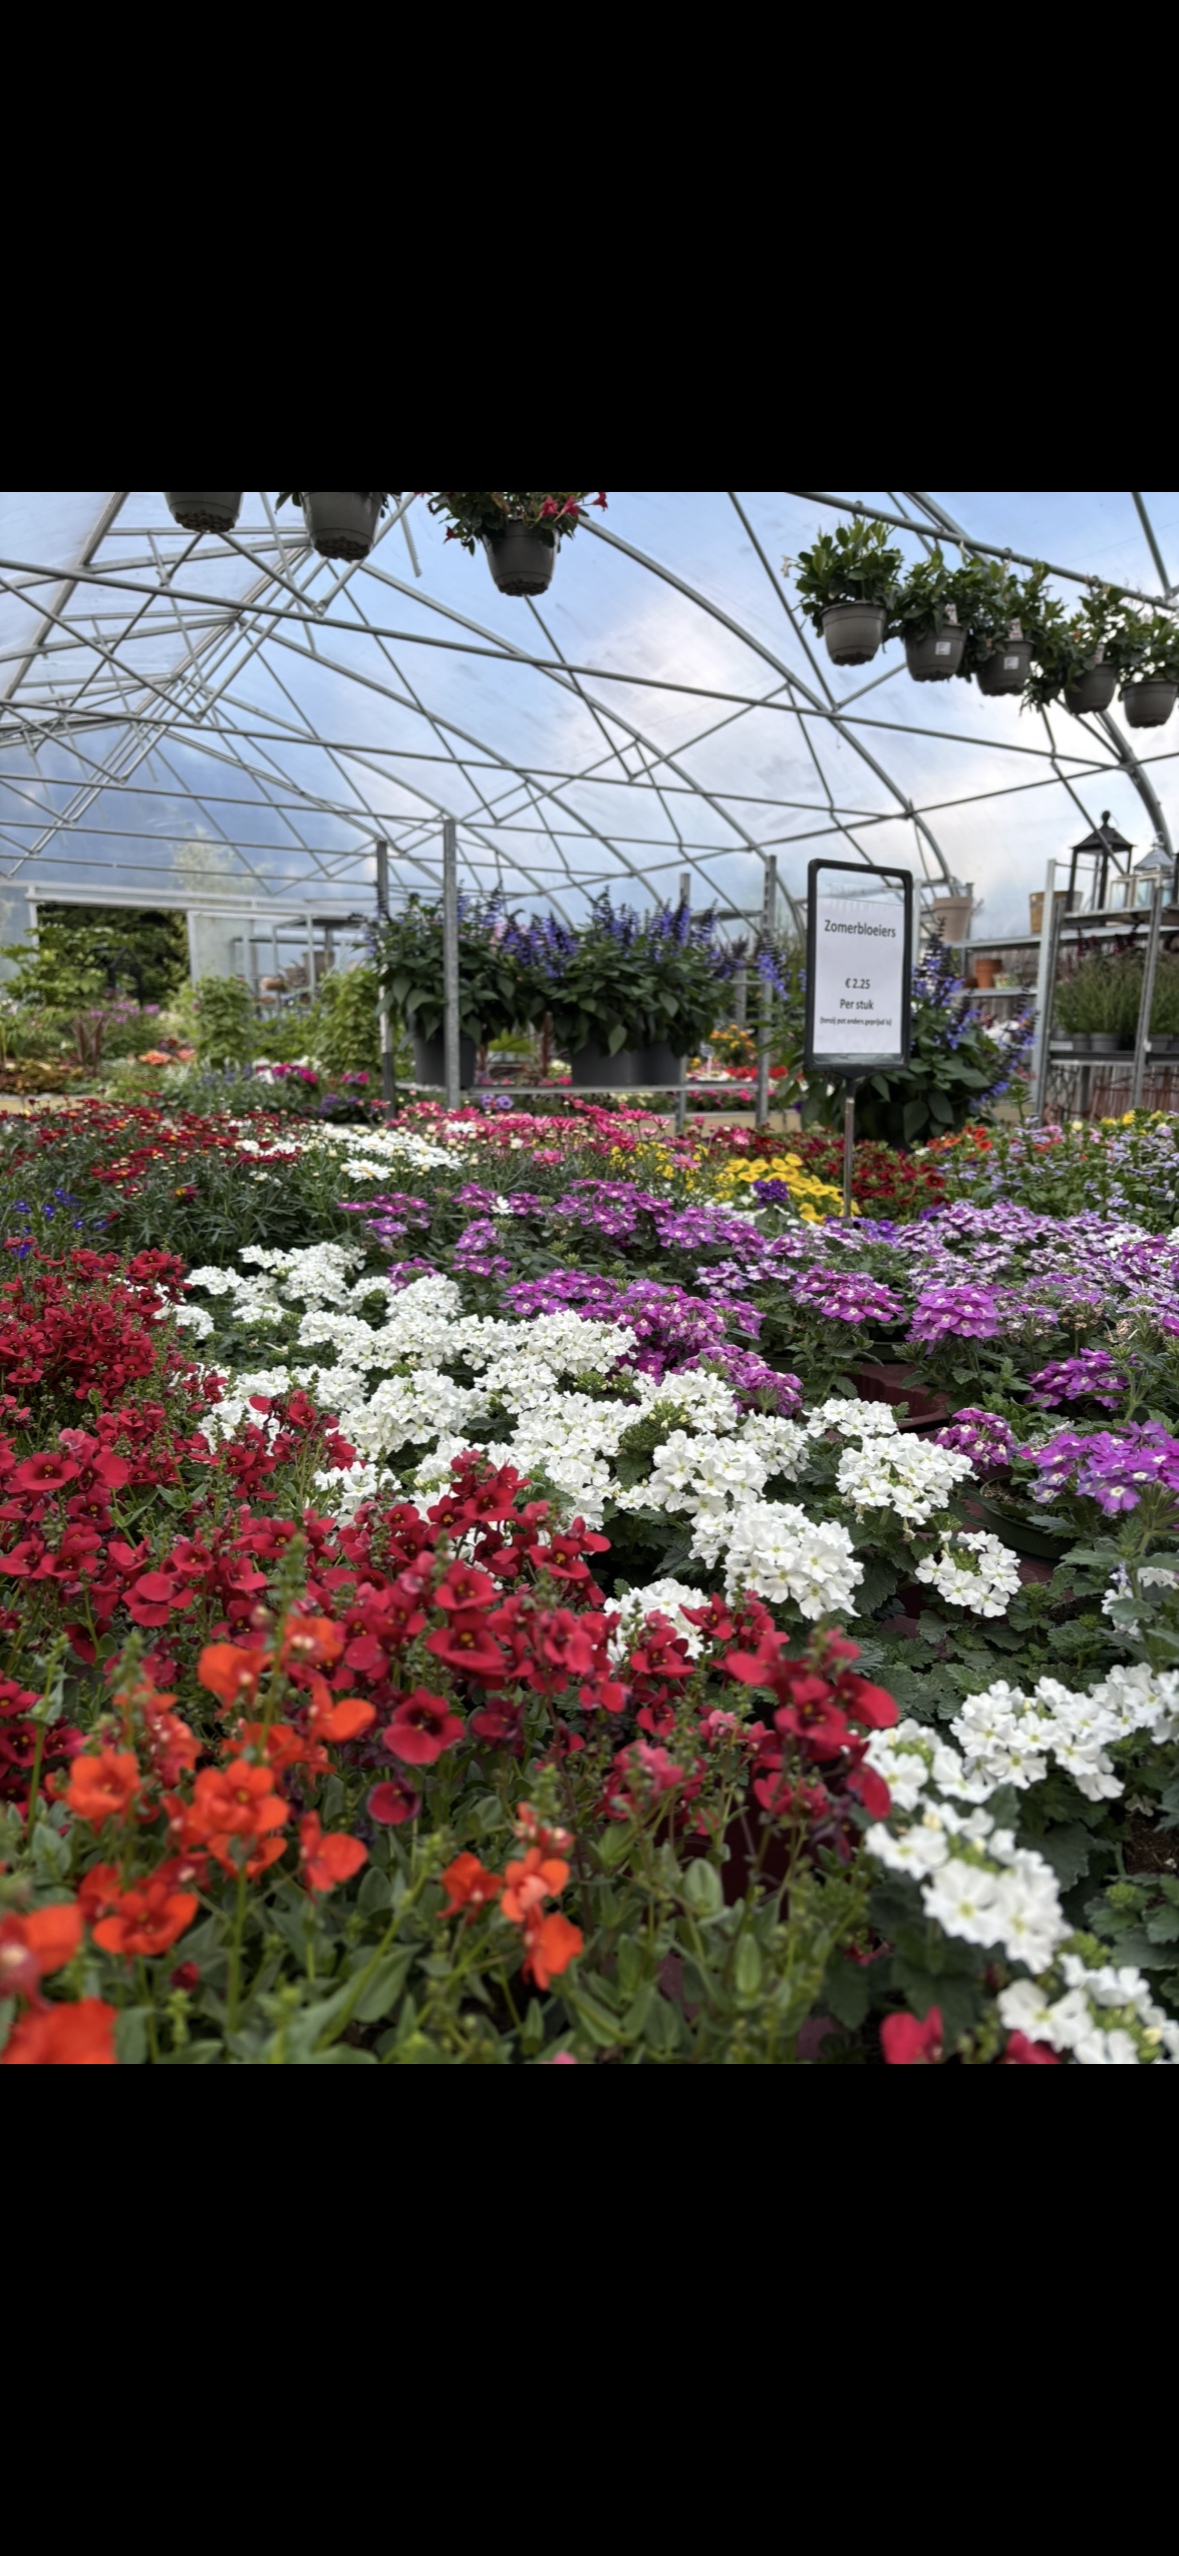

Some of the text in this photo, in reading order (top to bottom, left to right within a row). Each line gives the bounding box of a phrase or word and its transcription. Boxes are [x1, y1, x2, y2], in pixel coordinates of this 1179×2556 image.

[824, 919, 896, 938] Zomerbloeiers
[845, 978, 870, 989] € 2.25
[840, 999, 874, 1011] Per stuk
